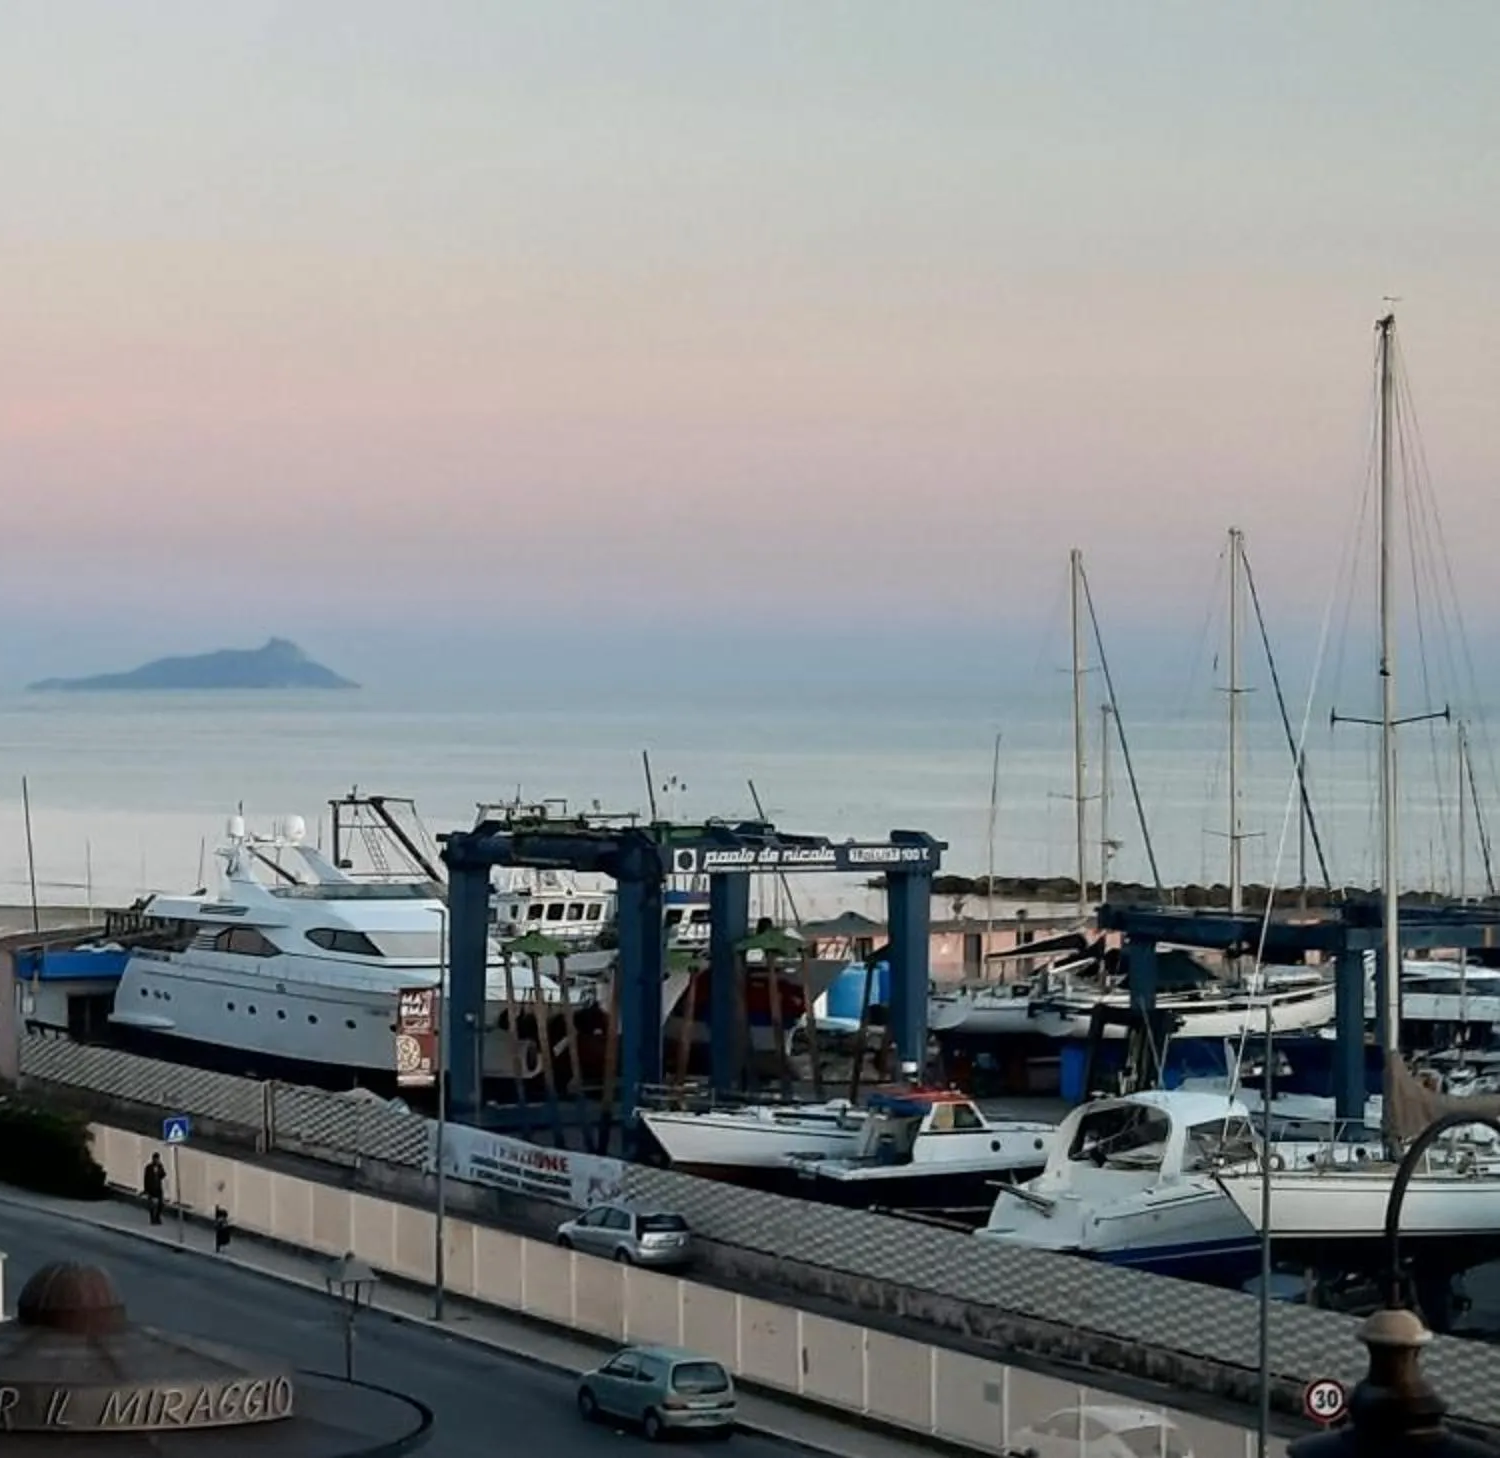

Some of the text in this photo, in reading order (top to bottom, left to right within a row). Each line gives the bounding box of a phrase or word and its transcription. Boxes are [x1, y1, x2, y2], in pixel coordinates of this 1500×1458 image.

[47, 1388, 72, 1425] IL
[101, 1376, 294, 1426] MIRAGGIO
[1315, 1389, 1339, 1409] 30
